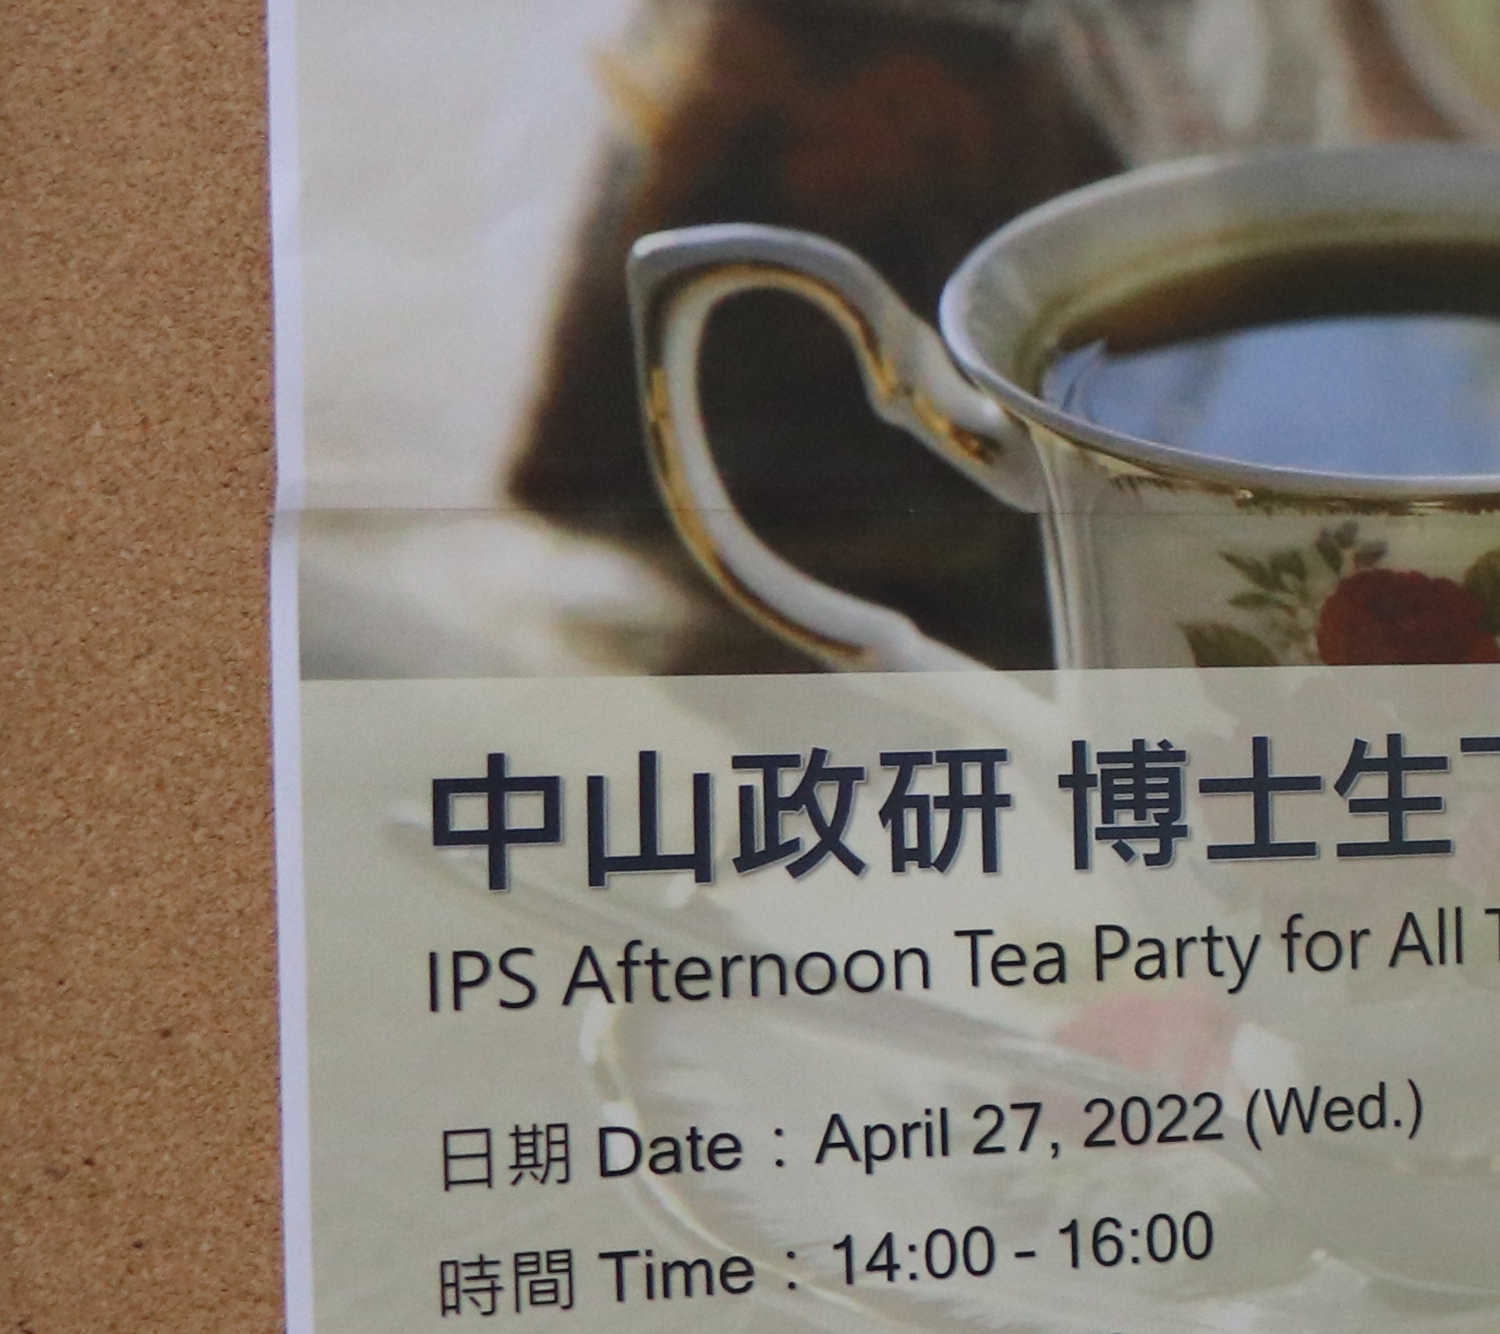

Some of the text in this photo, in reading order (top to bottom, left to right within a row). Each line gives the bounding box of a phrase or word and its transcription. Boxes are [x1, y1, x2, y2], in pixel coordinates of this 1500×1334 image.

[431, 747, 1012, 891] 中山政研
[428, 947, 537, 1013] IPS
[561, 939, 930, 1006] Afternoon
[953, 928, 1067, 988] Tea
[1095, 924, 1261, 995] Party
[1280, 912, 1371, 973] for
[1388, 906, 1464, 968] All
[442, 1122, 571, 1192] 日期
[814, 1106, 950, 1175] April
[972, 1101, 1060, 1159] 27,
[1083, 1091, 1224, 1149] 2022
[1246, 1078, 1423, 1151] (Wed.)
[439, 1248, 575, 1318] 時間
[832, 1225, 996, 1286] 14:00
[1058, 1210, 1214, 1269] 16:00
